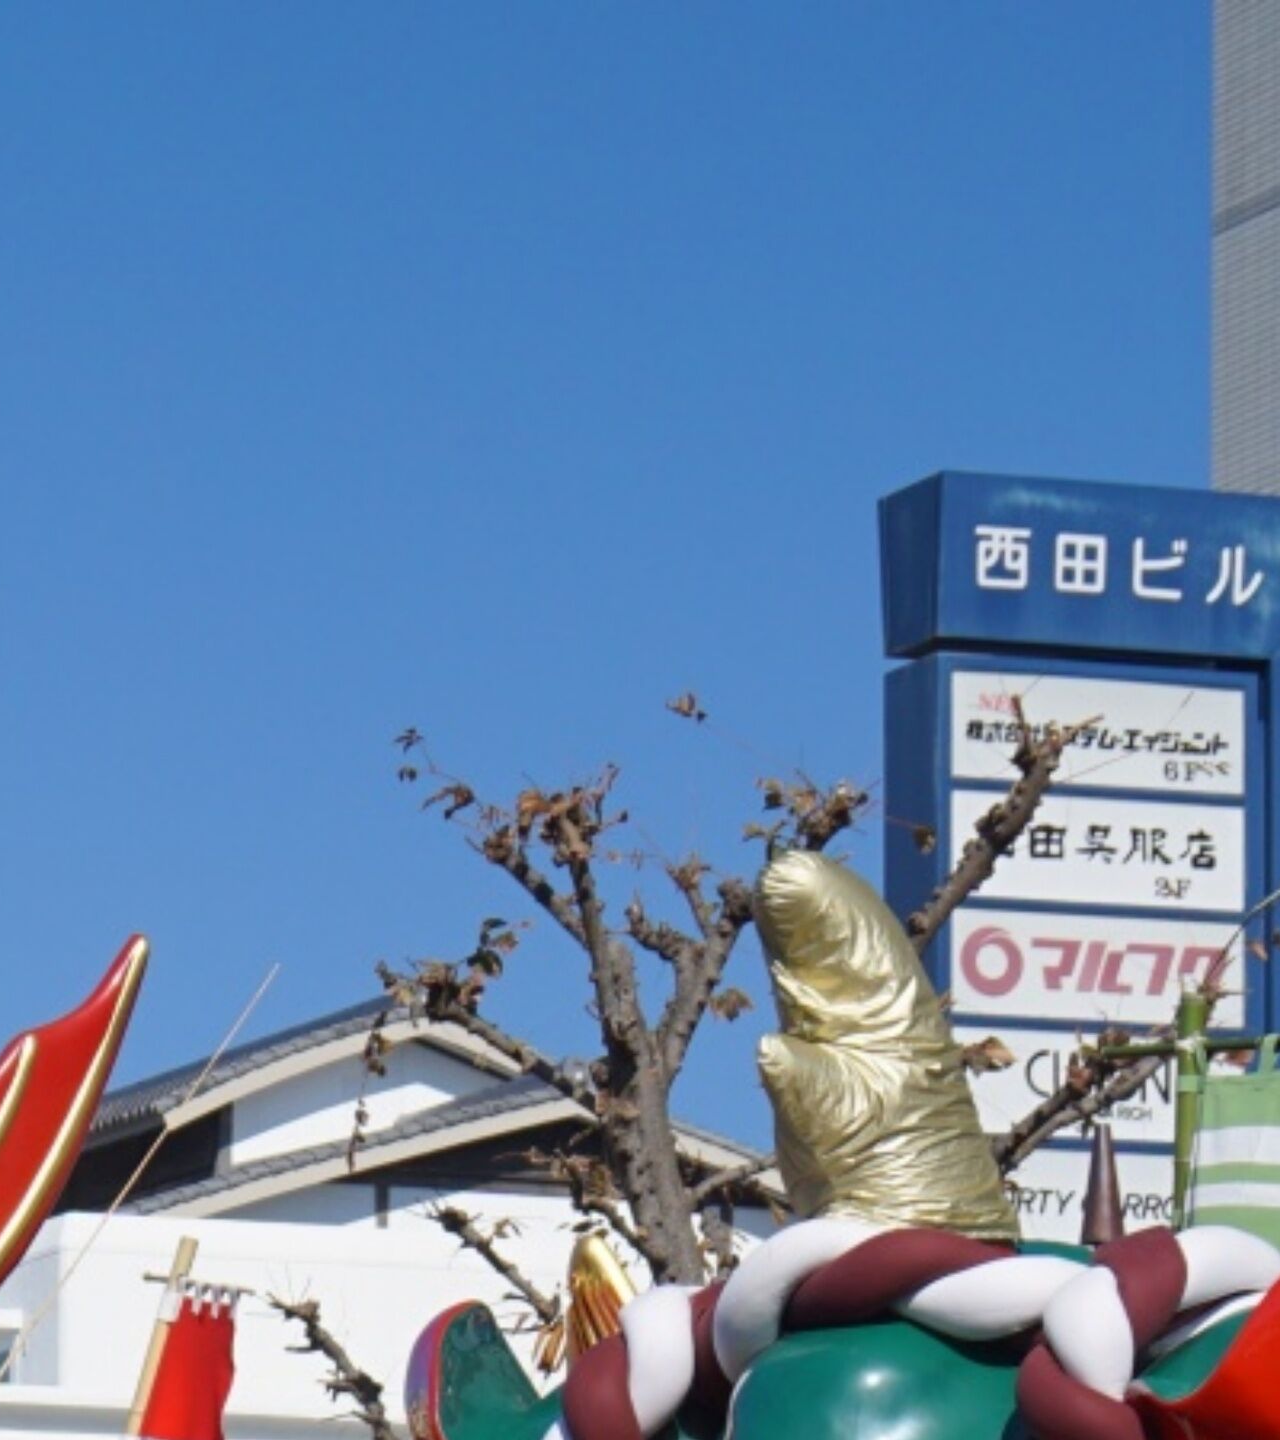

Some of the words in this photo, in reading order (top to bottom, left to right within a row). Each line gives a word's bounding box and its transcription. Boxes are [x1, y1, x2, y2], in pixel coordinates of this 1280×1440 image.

[974, 525, 1265, 605] 西田ビル
[993, 822, 1217, 870] 田呉服店
